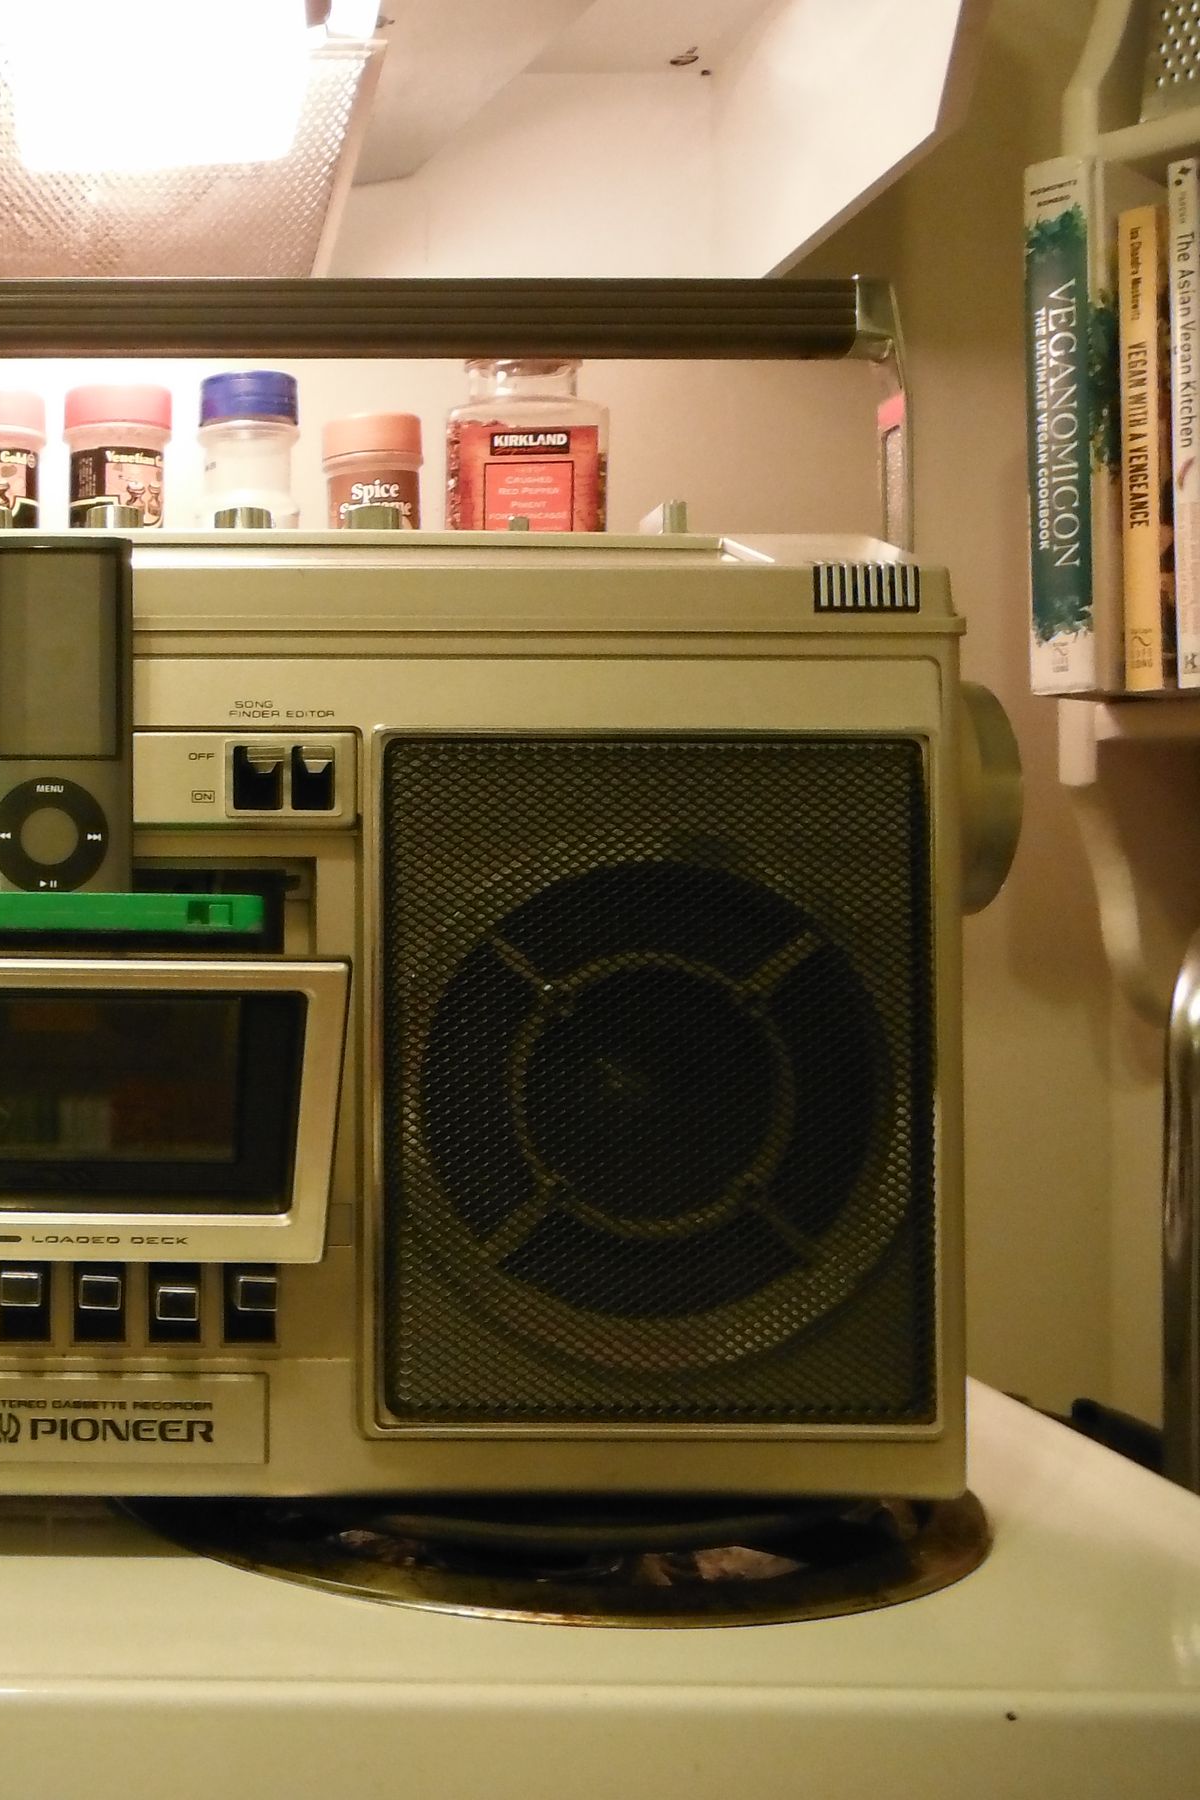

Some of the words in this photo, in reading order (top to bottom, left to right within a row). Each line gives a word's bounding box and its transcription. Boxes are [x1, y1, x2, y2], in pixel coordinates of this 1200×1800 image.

[1176, 231, 1195, 262] The
[1177, 269, 1196, 317] Asian
[1034, 306, 1046, 336] THE
[1180, 320, 1196, 375] Vegan
[1036, 339, 1048, 410] ULTIMATE
[1128, 341, 1147, 389] VEGAN
[1048, 278, 1081, 567] VEGANOMICON
[1128, 392, 1148, 428] WITH
[1180, 381, 1197, 448] Kitchen
[493, 433, 568, 448] KIRKLAND
[1037, 412, 1048, 464] VEGAN
[1129, 433, 1147, 441] A
[105, 450, 155, 465] Venetian
[351, 479, 399, 504] Spice
[1129, 445, 1150, 530] VENGEANCE
[1038, 467, 1050, 550] COOKBOOK
[229, 710, 280, 719] FINDER
[286, 710, 336, 718] EDITOR
[234, 700, 274, 709] SONG
[188, 752, 215, 761] OFF
[35, 784, 65, 793] MENU
[194, 792, 213, 801] ON
[31, 1235, 121, 1245] LOADED
[130, 1236, 189, 1245] DECK
[51, 1400, 127, 1410] CASSETTE
[132, 1401, 213, 1411] RECORDER
[30, 1418, 214, 1443] PIONEER
